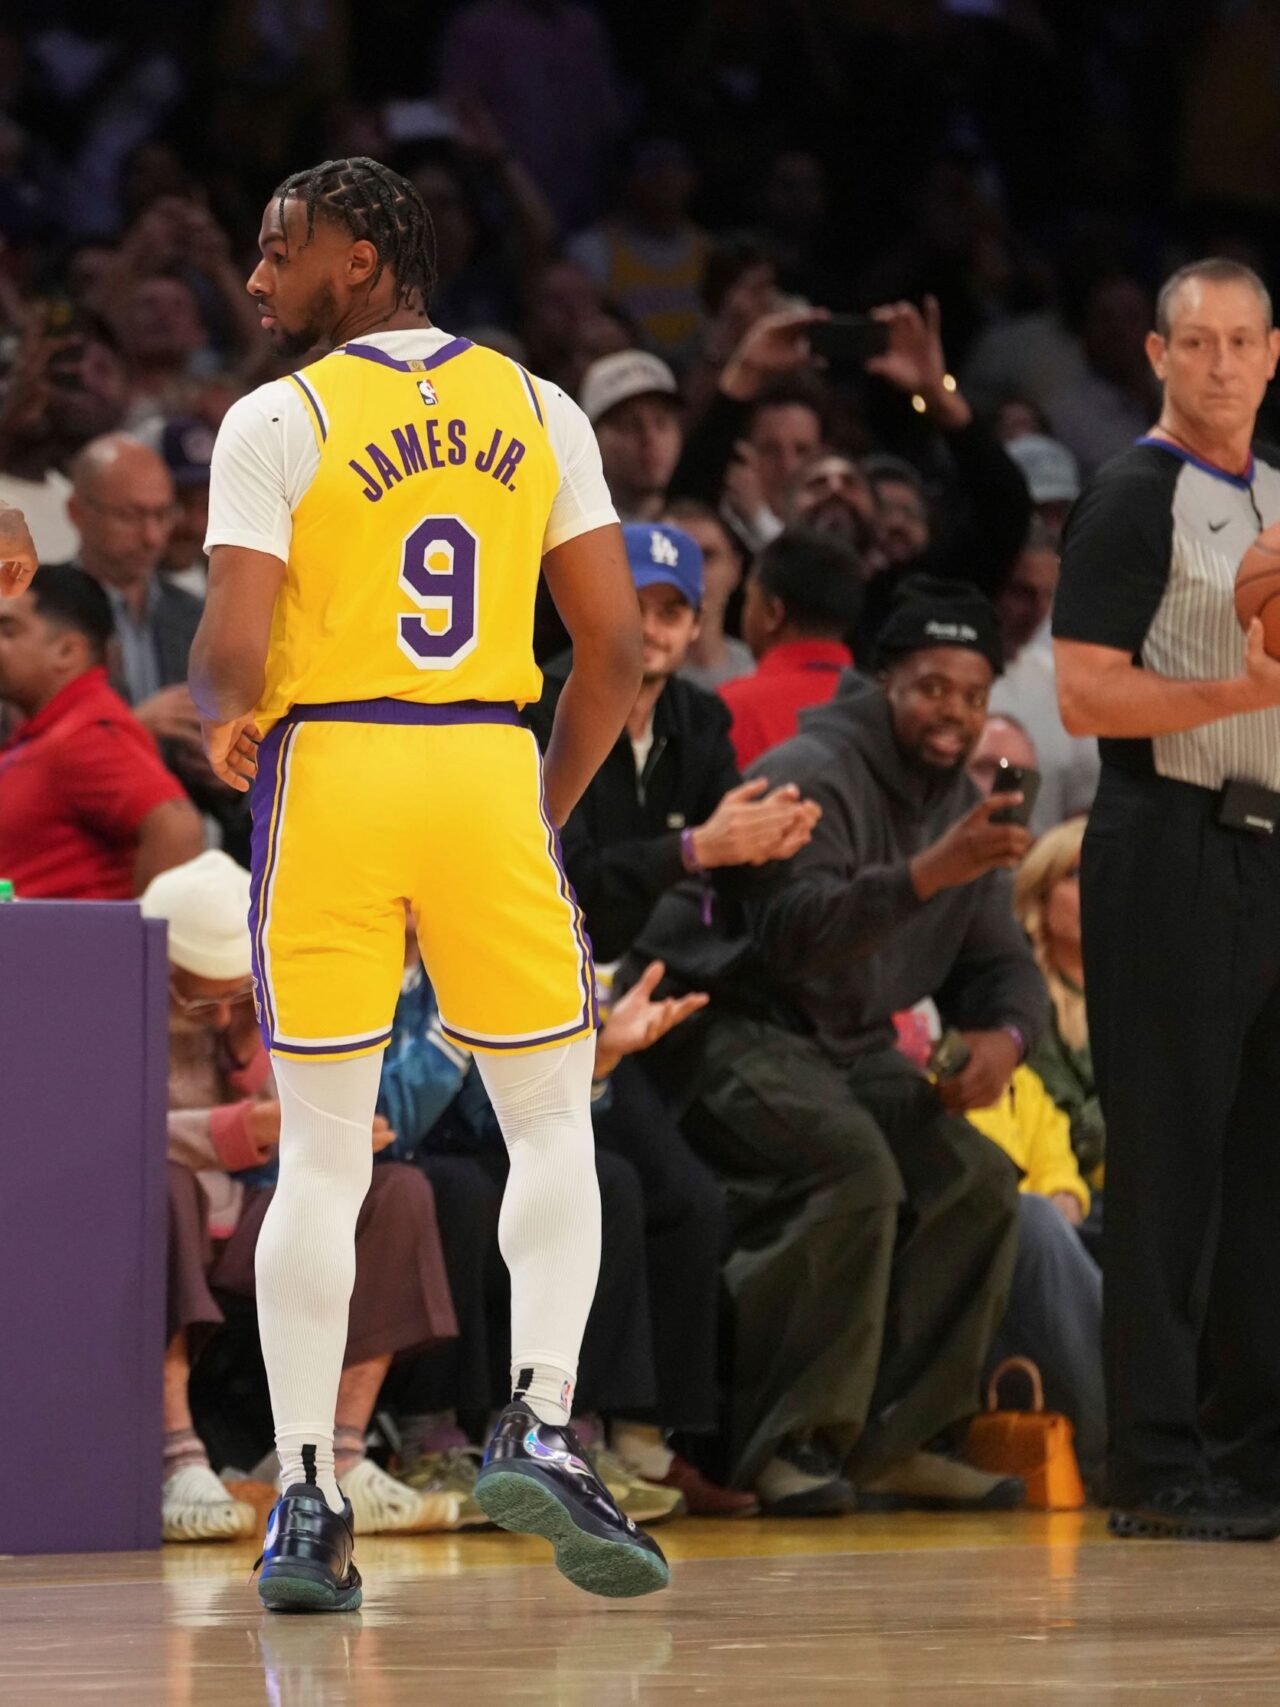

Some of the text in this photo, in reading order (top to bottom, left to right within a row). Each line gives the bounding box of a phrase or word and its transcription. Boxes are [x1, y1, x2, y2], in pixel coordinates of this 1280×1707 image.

[347, 418, 527, 503] JAMES JR.
[395, 512, 481, 671] 9
